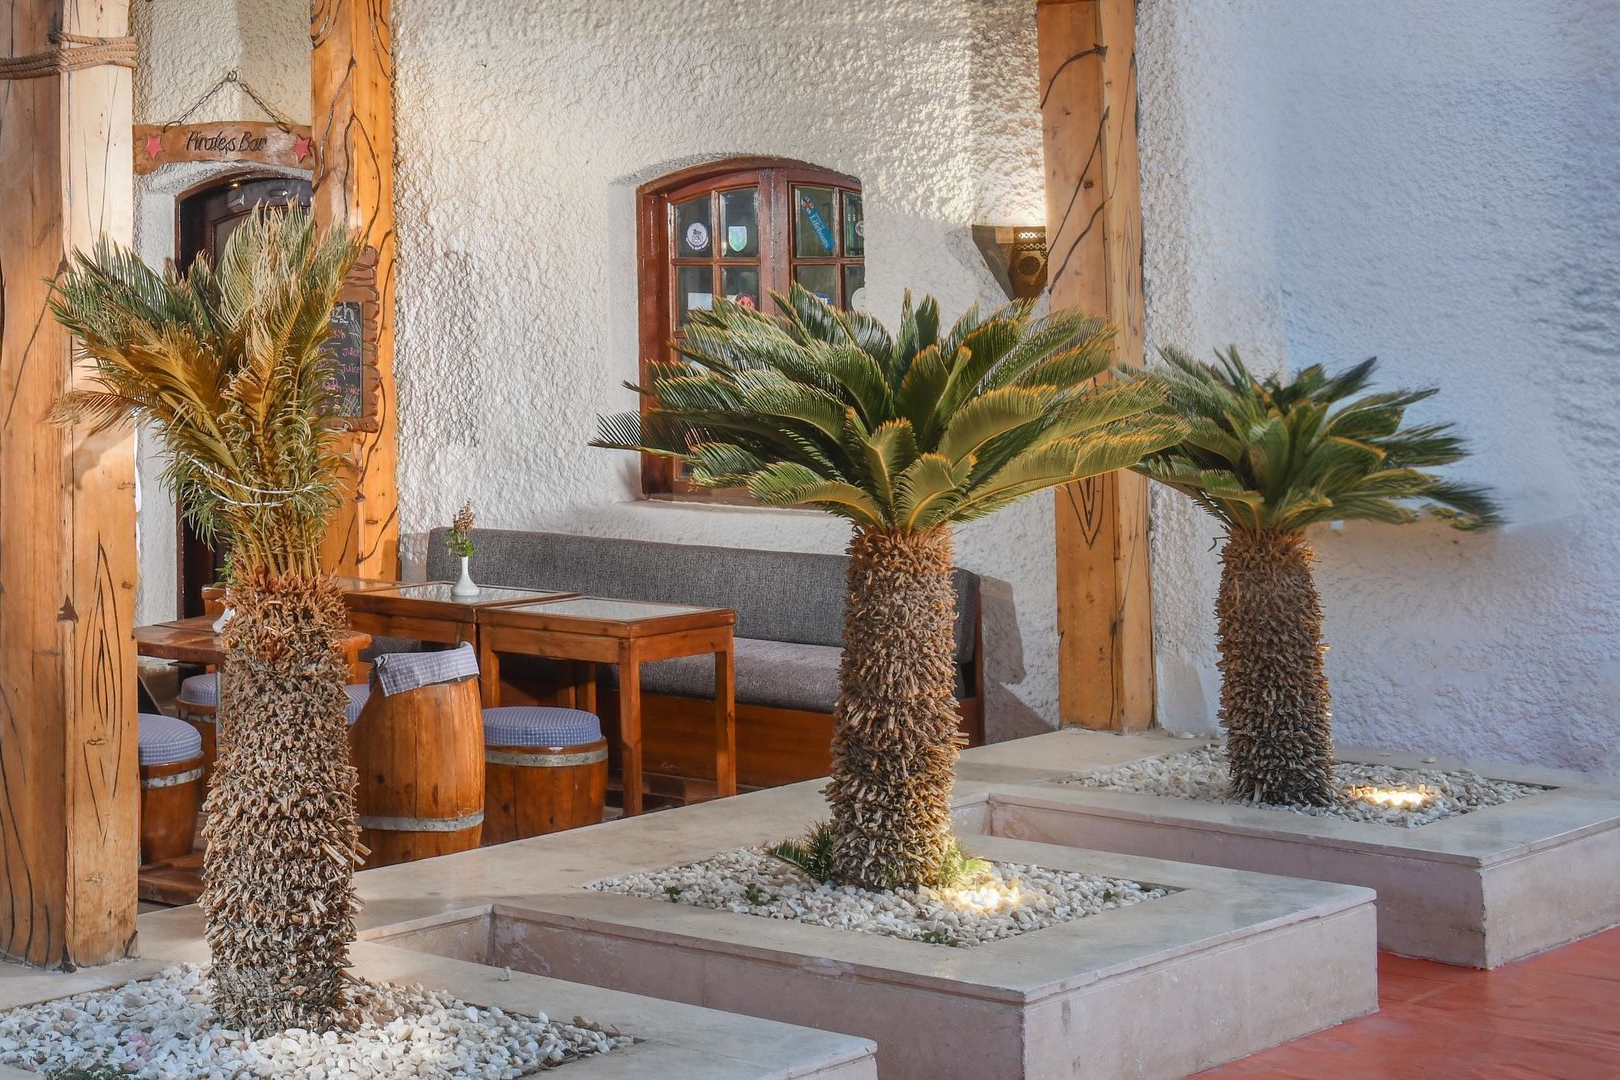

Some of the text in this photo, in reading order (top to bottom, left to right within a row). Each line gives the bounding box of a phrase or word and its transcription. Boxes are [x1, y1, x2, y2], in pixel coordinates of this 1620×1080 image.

[186, 130, 268, 154] Pirates Bar
[809, 214, 829, 249] Lifeboats
